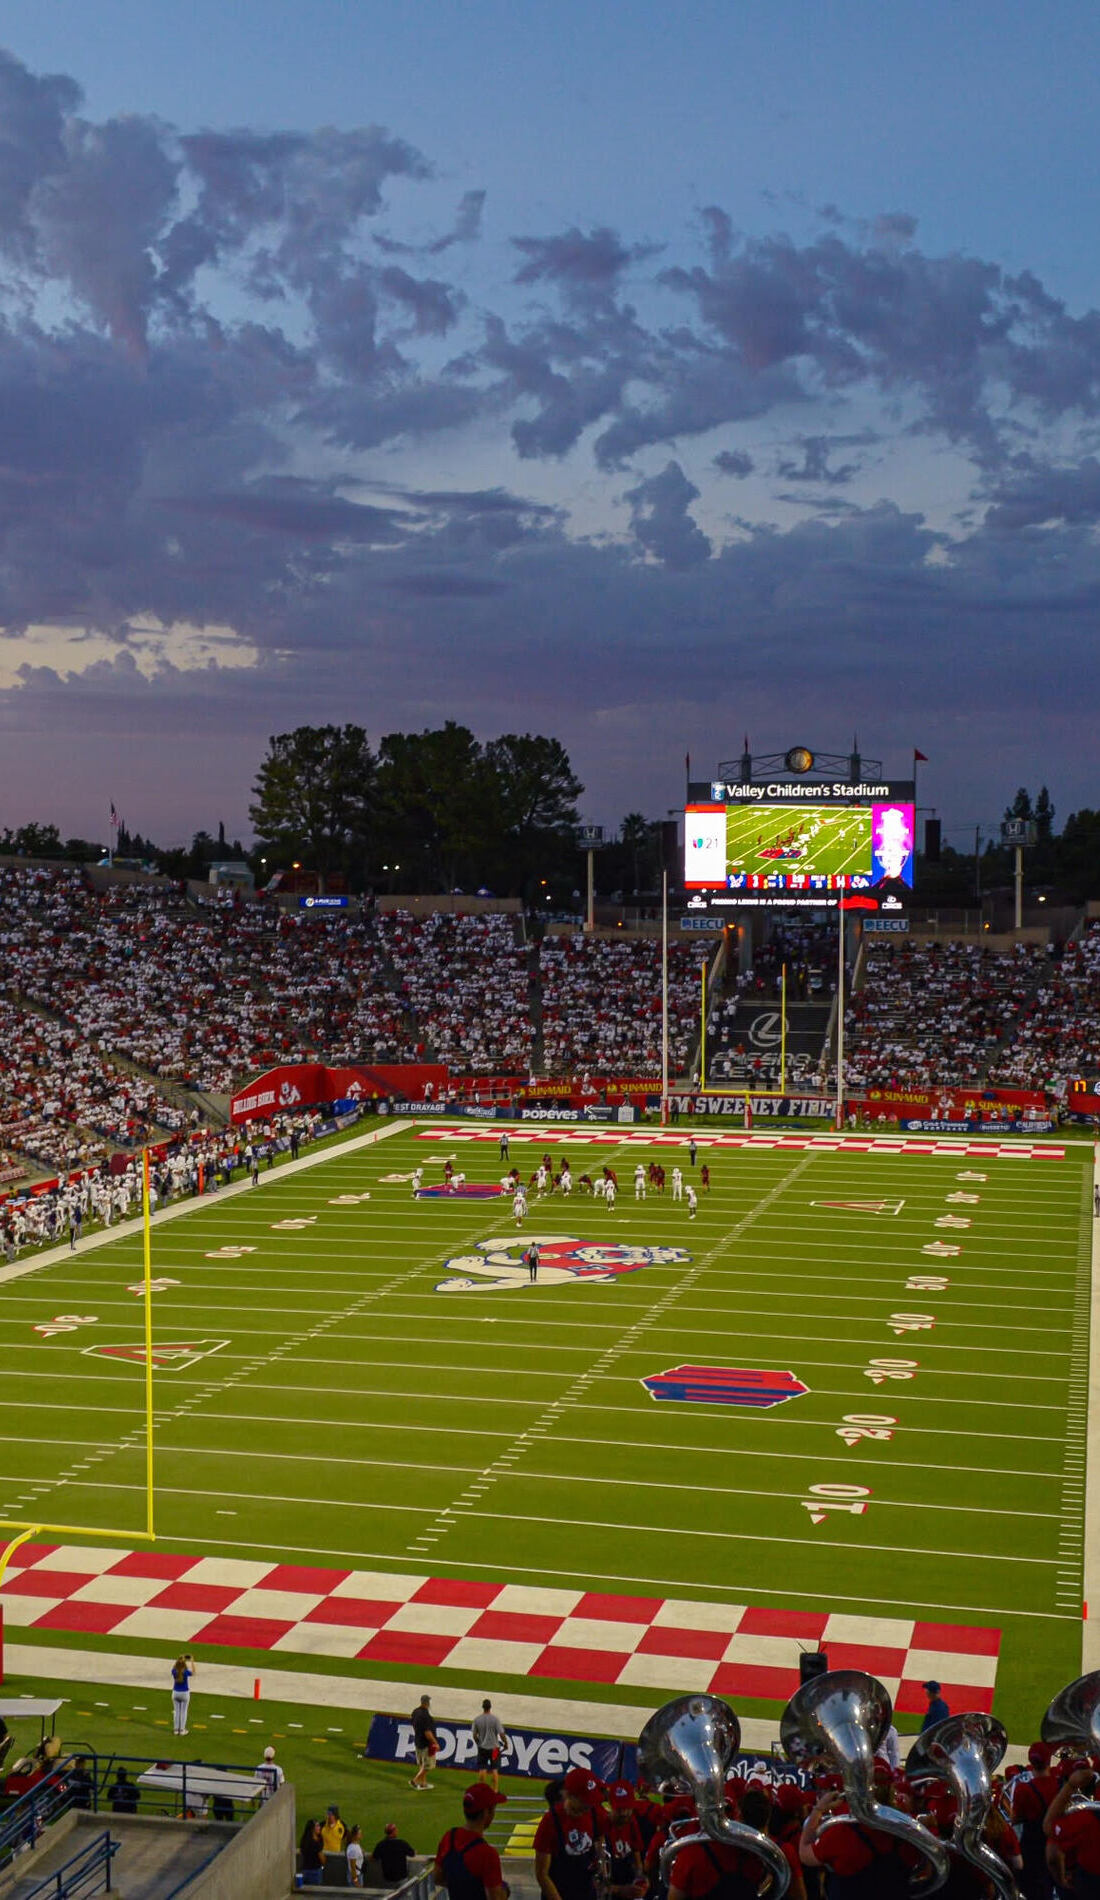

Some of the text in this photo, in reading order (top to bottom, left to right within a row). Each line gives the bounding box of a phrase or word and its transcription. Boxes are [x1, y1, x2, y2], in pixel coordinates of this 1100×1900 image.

[727, 783, 889, 799] Valley Children's Stadium
[706, 838, 718, 849] 21
[692, 919, 723, 929] EECU
[876, 920, 907, 930] EECU
[1074, 1080, 1087, 1092] 17
[393, 1103, 409, 1112] EST
